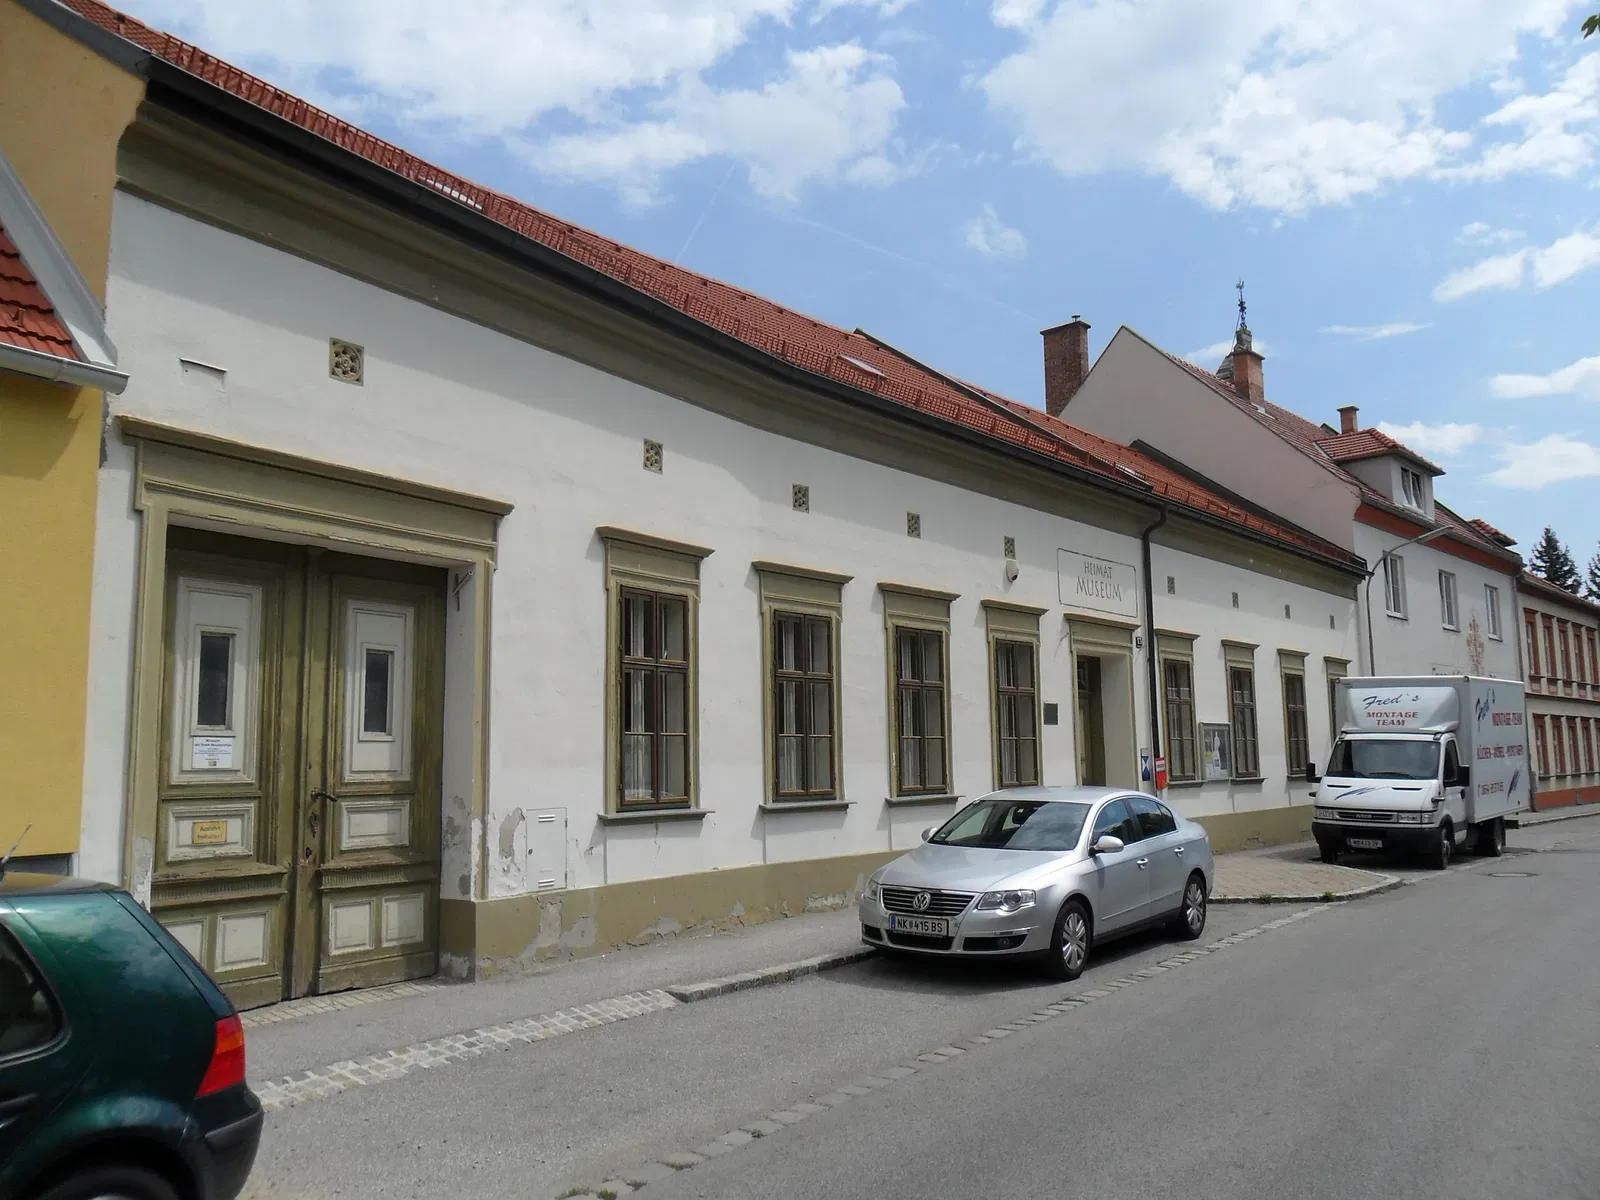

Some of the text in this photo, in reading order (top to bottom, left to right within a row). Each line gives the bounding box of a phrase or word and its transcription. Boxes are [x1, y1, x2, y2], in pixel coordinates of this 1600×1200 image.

[1083, 561, 1113, 579] HEIMAT
[1076, 575, 1122, 602] MUSEUM
[1365, 711, 1419, 719] MONTAGE
[897, 918, 943, 933] NK 415 BS
